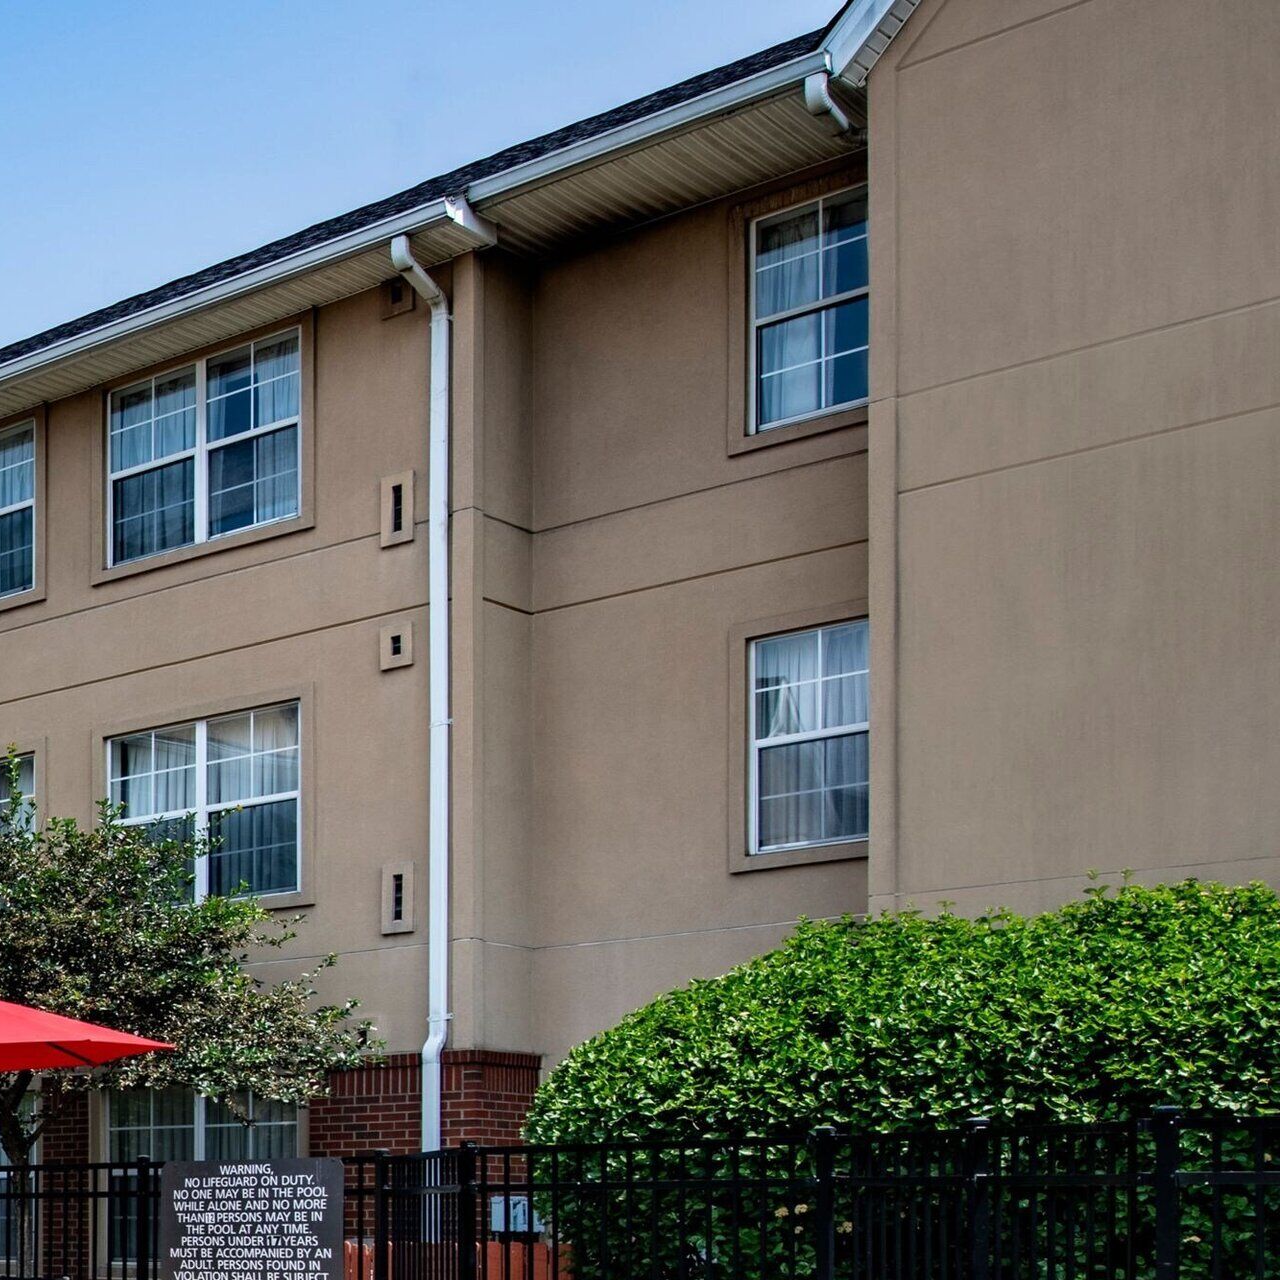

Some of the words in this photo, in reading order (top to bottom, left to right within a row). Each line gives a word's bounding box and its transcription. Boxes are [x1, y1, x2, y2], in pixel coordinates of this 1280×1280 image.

[220, 1163, 274, 1175] WARNING,
[185, 1178, 200, 1188] NO
[203, 1176, 257, 1187] LIFEGUARD
[261, 1175, 278, 1186] ON
[281, 1175, 315, 1185] DUTY.
[173, 1190, 189, 1200] NO
[191, 1189, 212, 1200] ONE
[215, 1189, 240, 1199] MAY
[242, 1188, 255, 1199] BE
[258, 1188, 269, 1198] IN
[272, 1187, 293, 1198] THE
[297, 1187, 328, 1198] POOL
[173, 1201, 204, 1211] WHILE
[207, 1200, 241, 1211] ALONE
[245, 1200, 269, 1210] AND
[272, 1200, 289, 1210] NO
[293, 1199, 327, 1209] MORE
[217, 1212, 262, 1223] PERSONS
[265, 1212, 291, 1222] MAY
[294, 1211, 308, 1222] BE
[311, 1211, 323, 1221] IN
[186, 1224, 205, 1234] THE
[208, 1224, 236, 1235] POOL
[239, 1224, 252, 1234] AT
[255, 1224, 279, 1234] ANY
[282, 1224, 312, 1234] TIME.
[181, 1236, 225, 1246] PERSONS
[228, 1236, 263, 1246] UNDER
[282, 1236, 318, 1246] YEARS
[170, 1248, 198, 1258] MUST
[201, 1248, 212, 1258] BE
[216, 1248, 293, 1259] ACCOMPANIED
[297, 1248, 311, 1258] BY
[314, 1248, 332, 1259] AN
[180, 1260, 214, 1270] ADULT.
[218, 1260, 263, 1270] PERSONS
[267, 1260, 305, 1270] FOUND
[309, 1260, 321, 1270] IN
